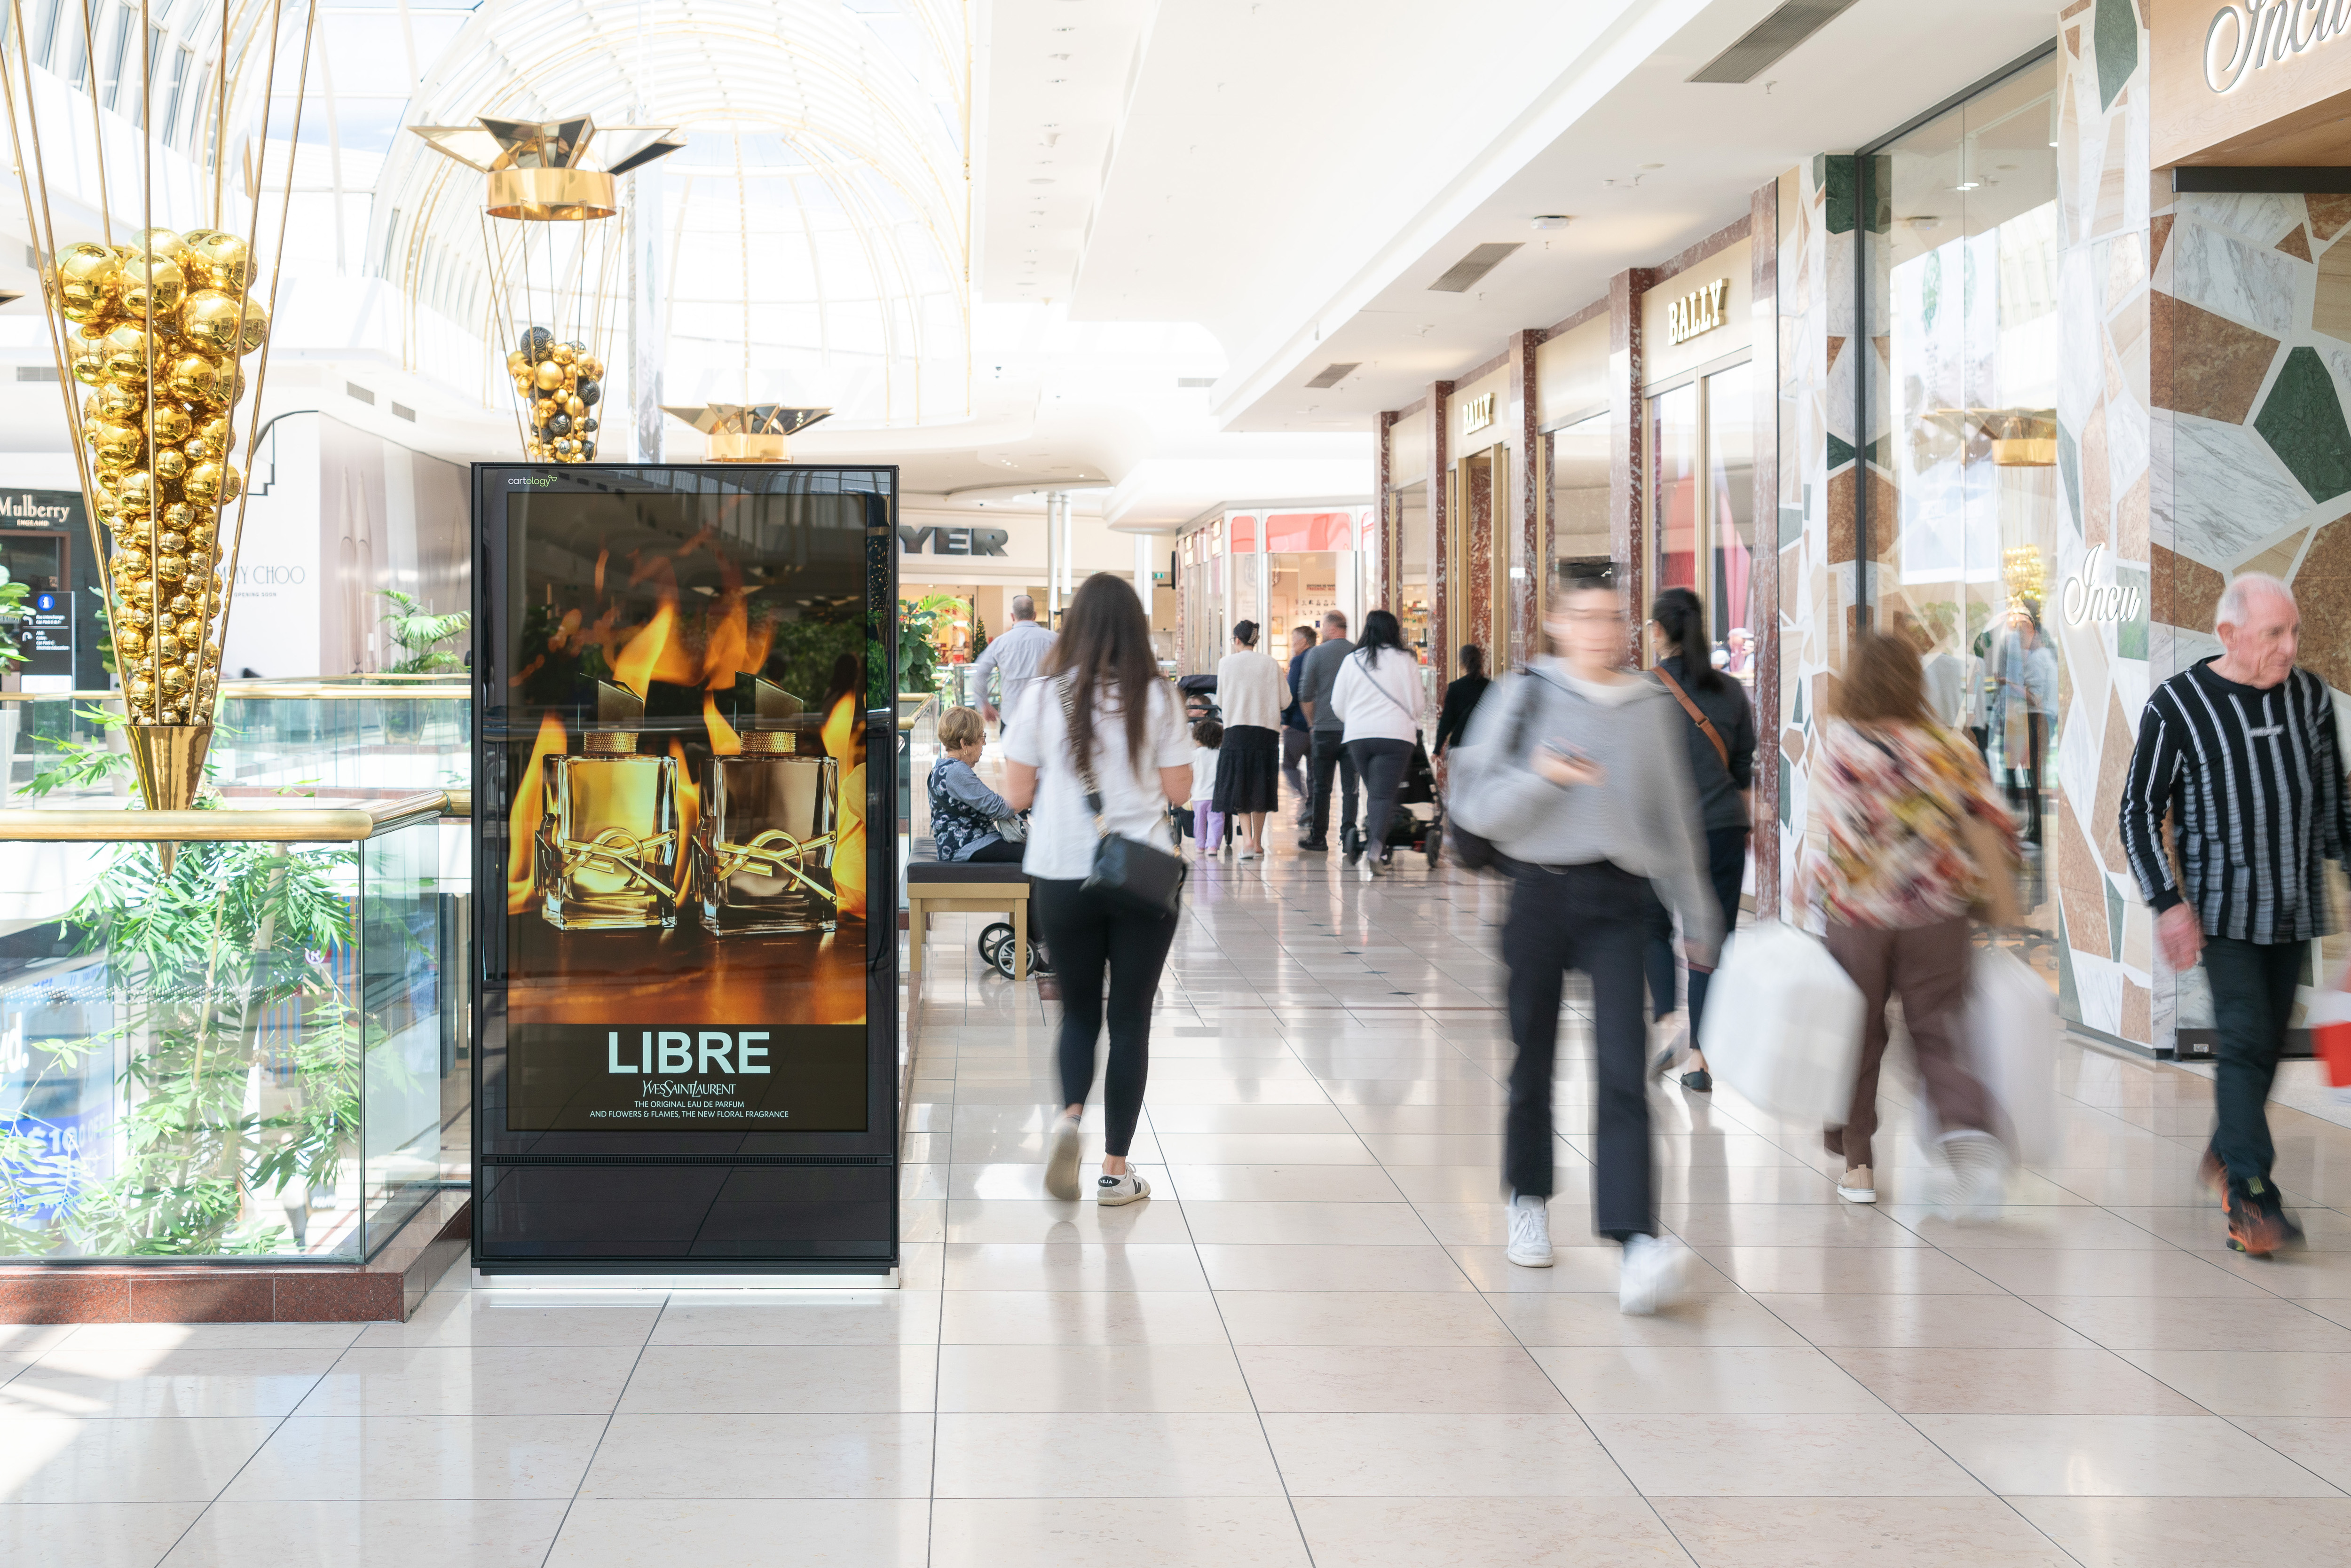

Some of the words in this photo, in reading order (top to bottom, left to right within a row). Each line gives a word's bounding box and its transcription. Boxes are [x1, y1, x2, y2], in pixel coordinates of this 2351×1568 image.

[1668, 278, 1727, 346] BALLY
[1463, 392, 1493, 435] BALLY
[508, 476, 551, 487] cartology
[0, 494, 70, 523] Mulberry
[253, 566, 305, 584] CHOO
[2062, 542, 2142, 625] Incu
[609, 1032, 770, 1073] LIBRE
